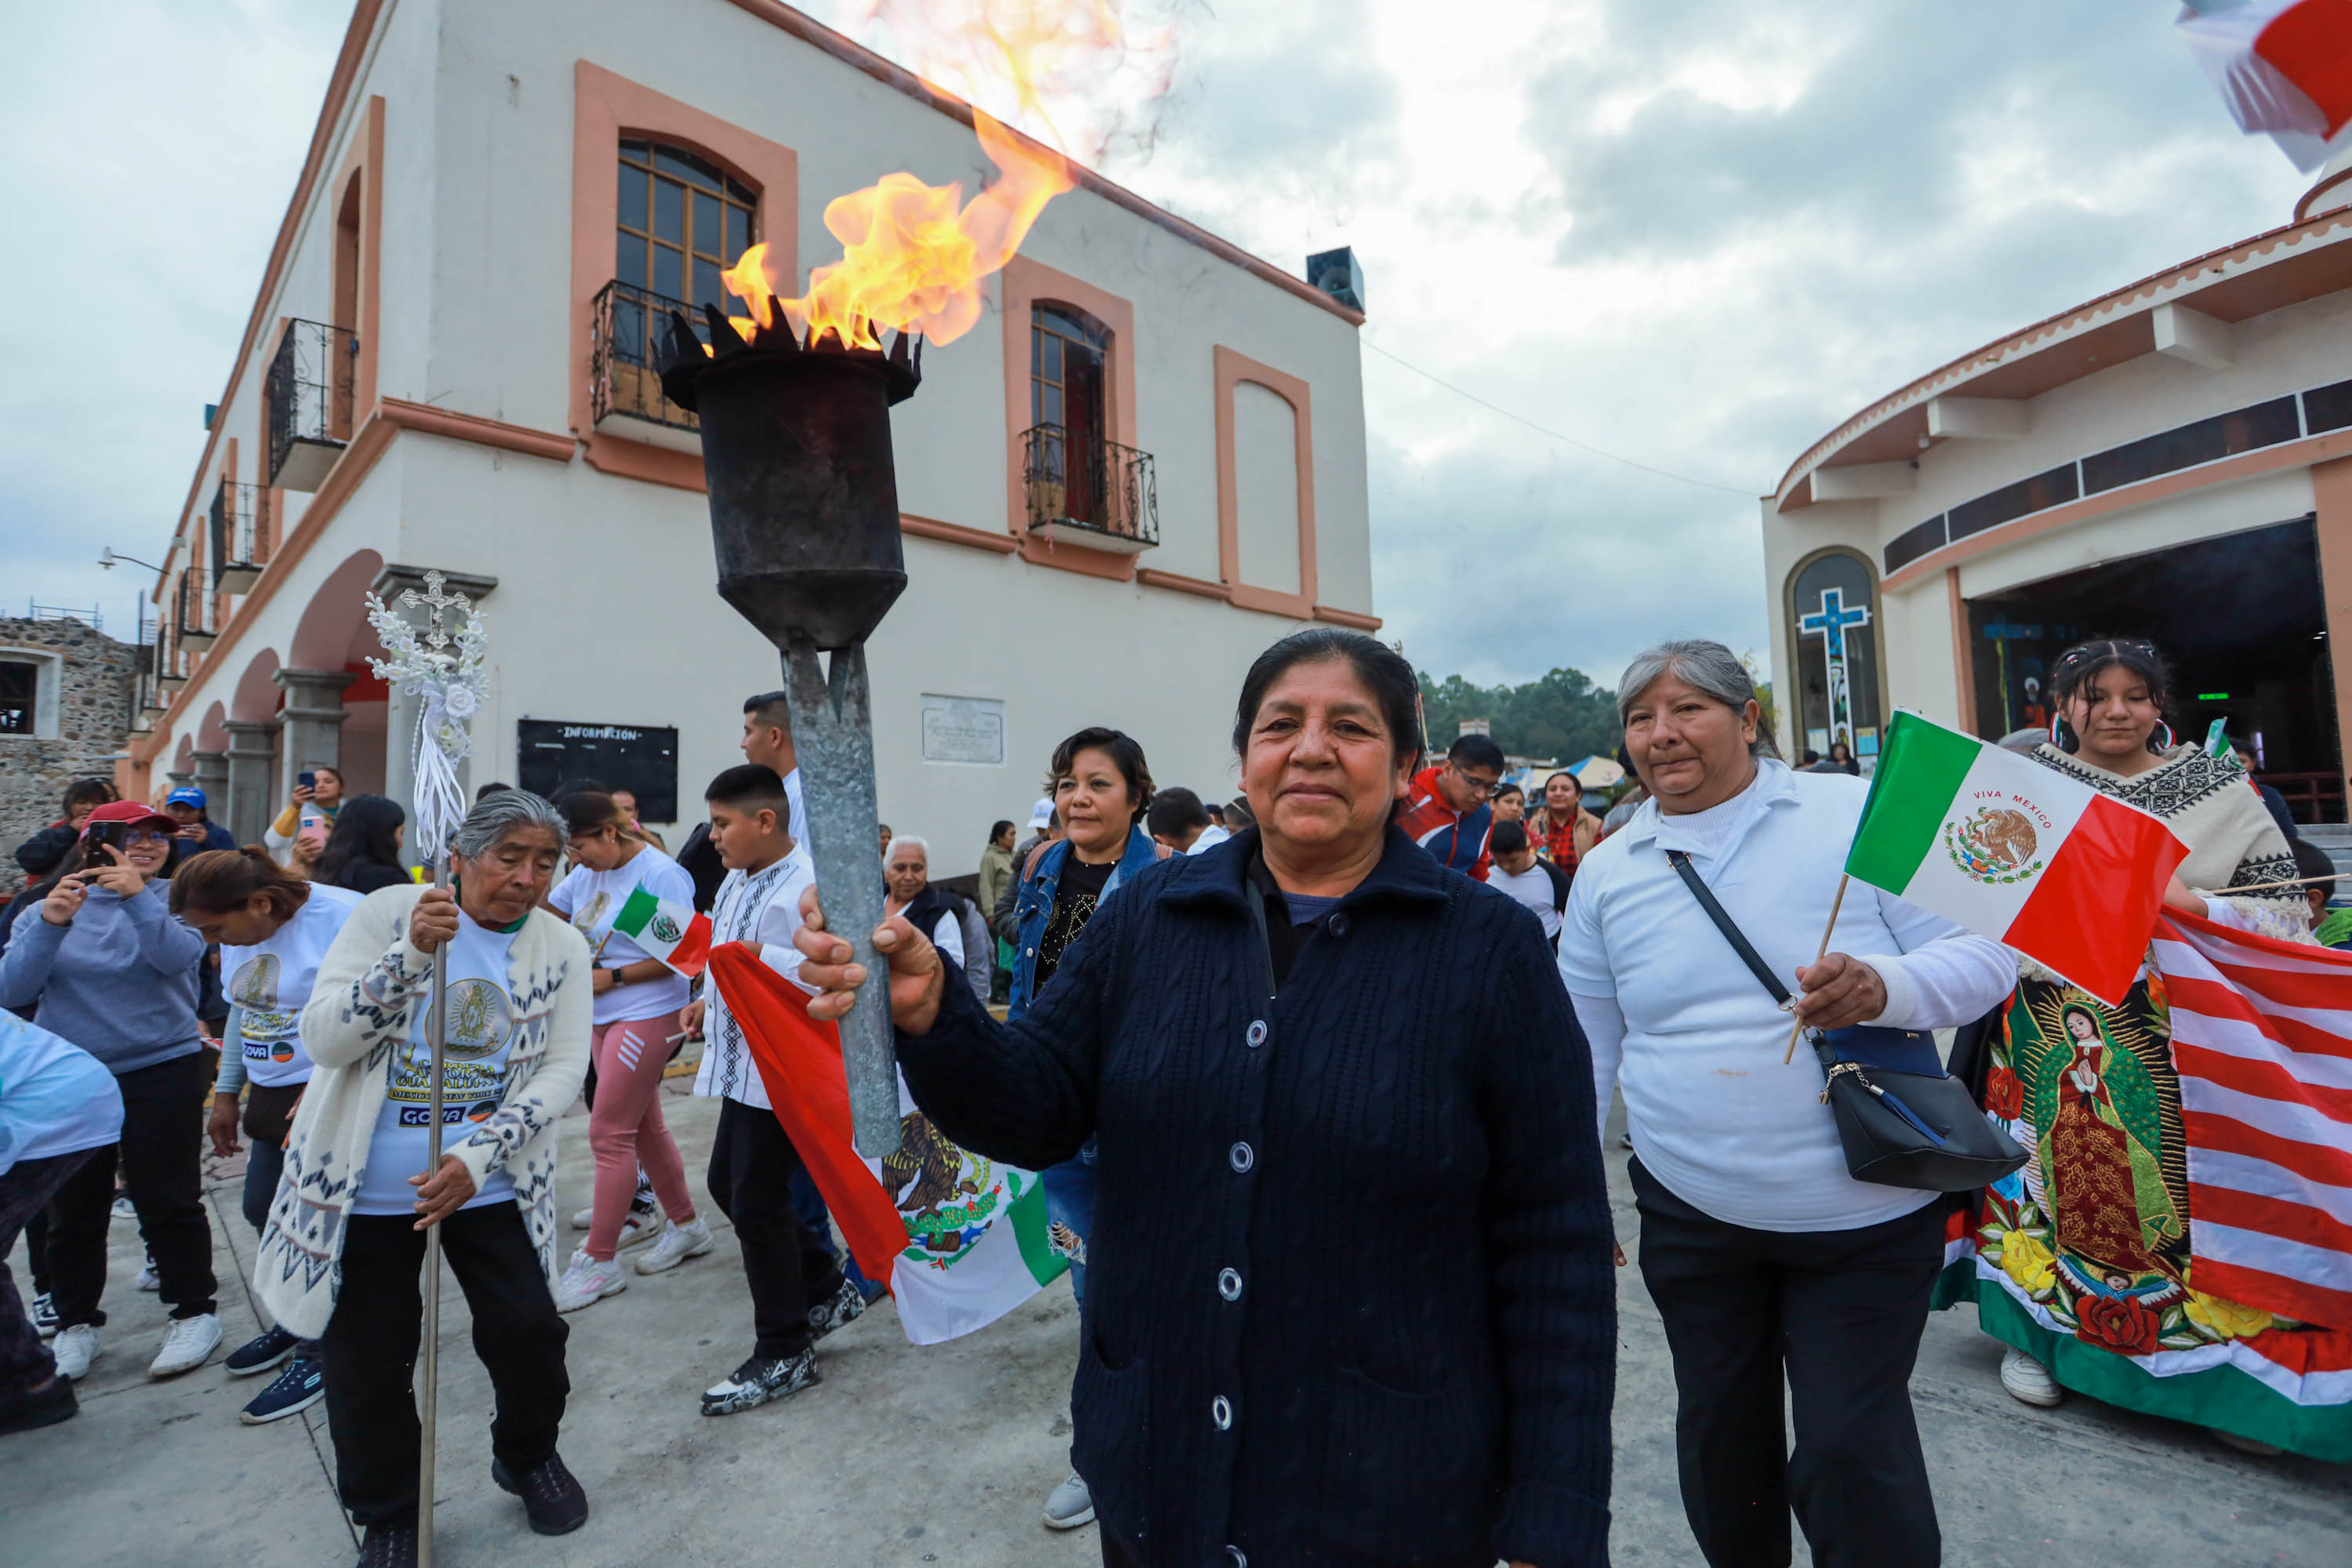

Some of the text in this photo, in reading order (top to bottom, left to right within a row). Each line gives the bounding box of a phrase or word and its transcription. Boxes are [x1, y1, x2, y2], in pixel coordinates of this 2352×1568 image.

[1973, 790, 2052, 829] VIVA MEXICO
[245, 1044, 267, 1058] OYA
[417, 1059, 495, 1073] CRRERA
